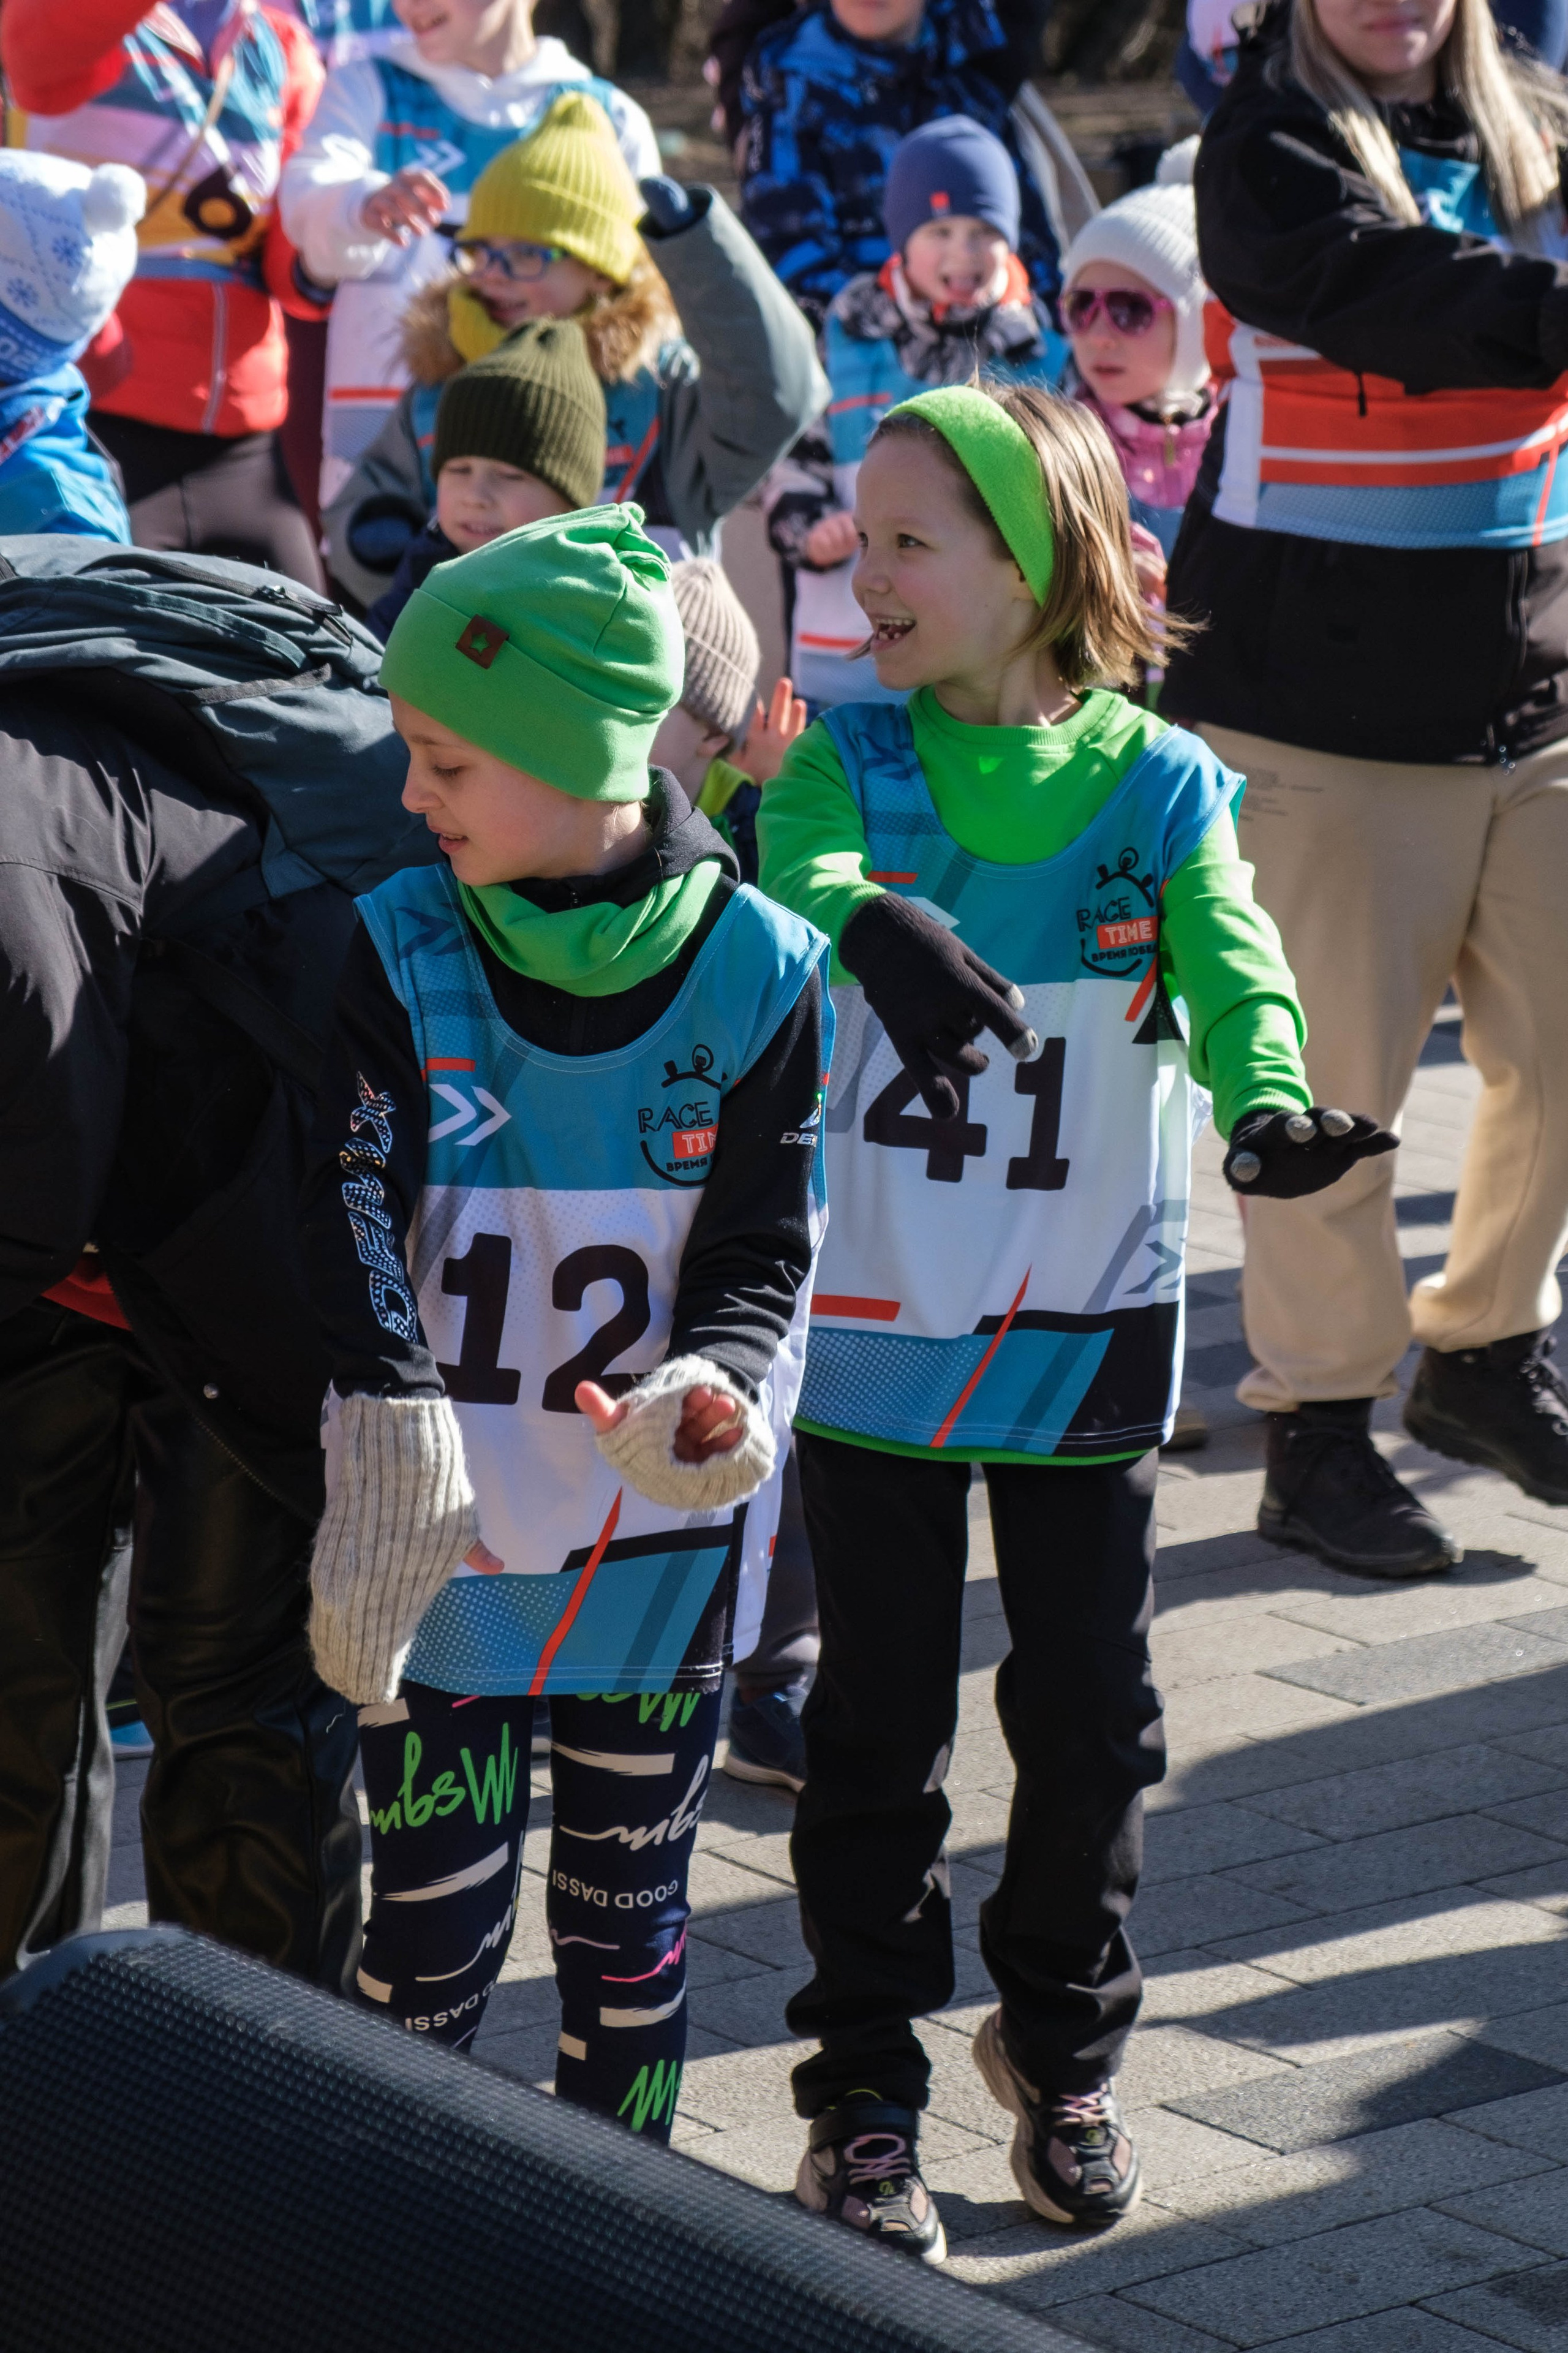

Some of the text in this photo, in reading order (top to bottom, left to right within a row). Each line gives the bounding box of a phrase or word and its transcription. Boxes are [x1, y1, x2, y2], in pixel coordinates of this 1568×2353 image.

[1076, 897, 1132, 932] RACE
[1105, 920, 1153, 945] TIME
[1091, 949, 1127, 962] ВРЕМЯ
[638, 1101, 714, 1133] RACE
[864, 1037, 1070, 1191] 41
[666, 1157, 707, 1172] ВРЕМЯ
[435, 1233, 652, 1414] 12
[552, 1870, 679, 1909] GOOD DASSI
